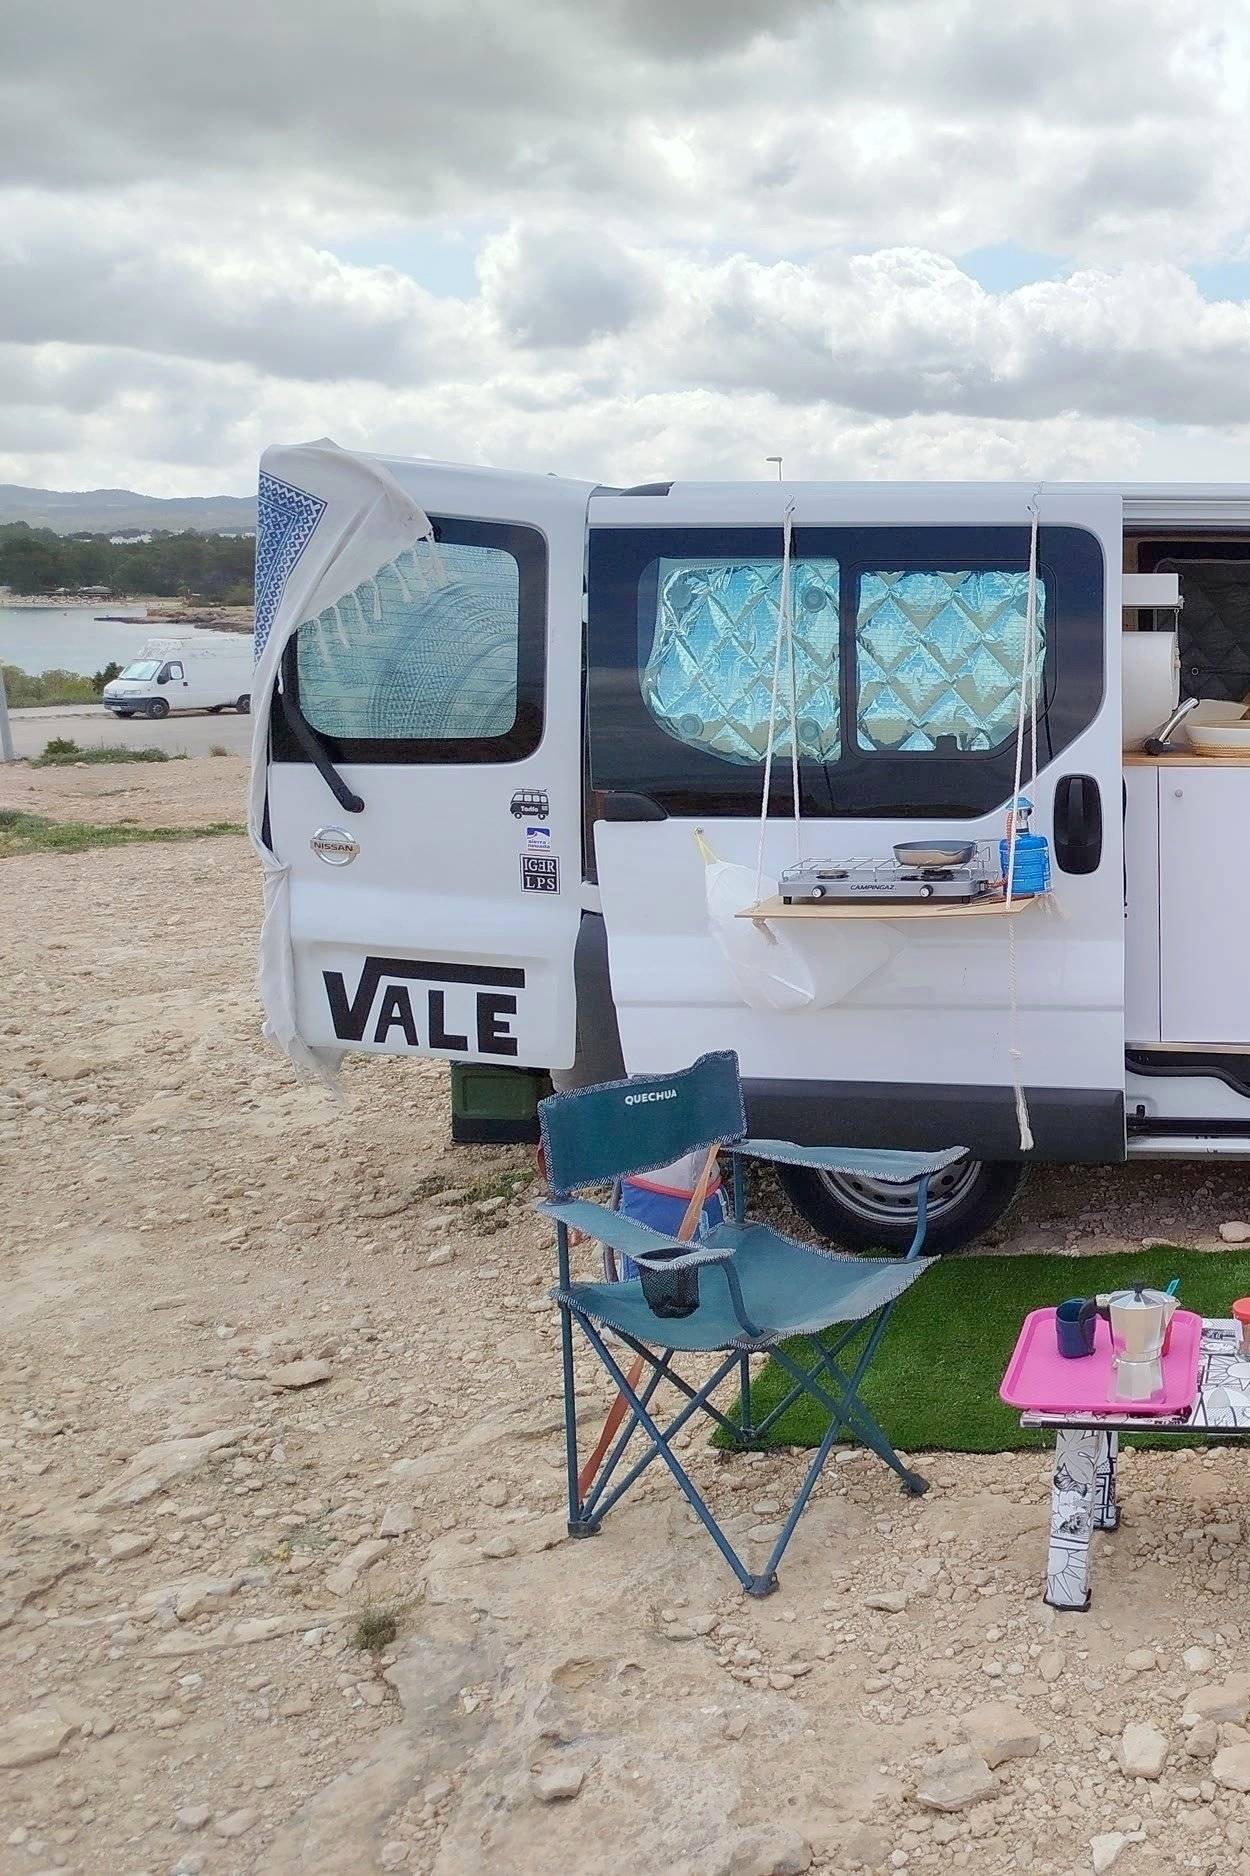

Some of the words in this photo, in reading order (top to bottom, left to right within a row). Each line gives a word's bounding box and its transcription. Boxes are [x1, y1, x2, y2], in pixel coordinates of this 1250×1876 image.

[313, 841, 354, 852] NISSAN
[525, 876, 556, 890] LPS
[322, 956, 526, 1056] VALE
[624, 1088, 678, 1105] QUECHUA
